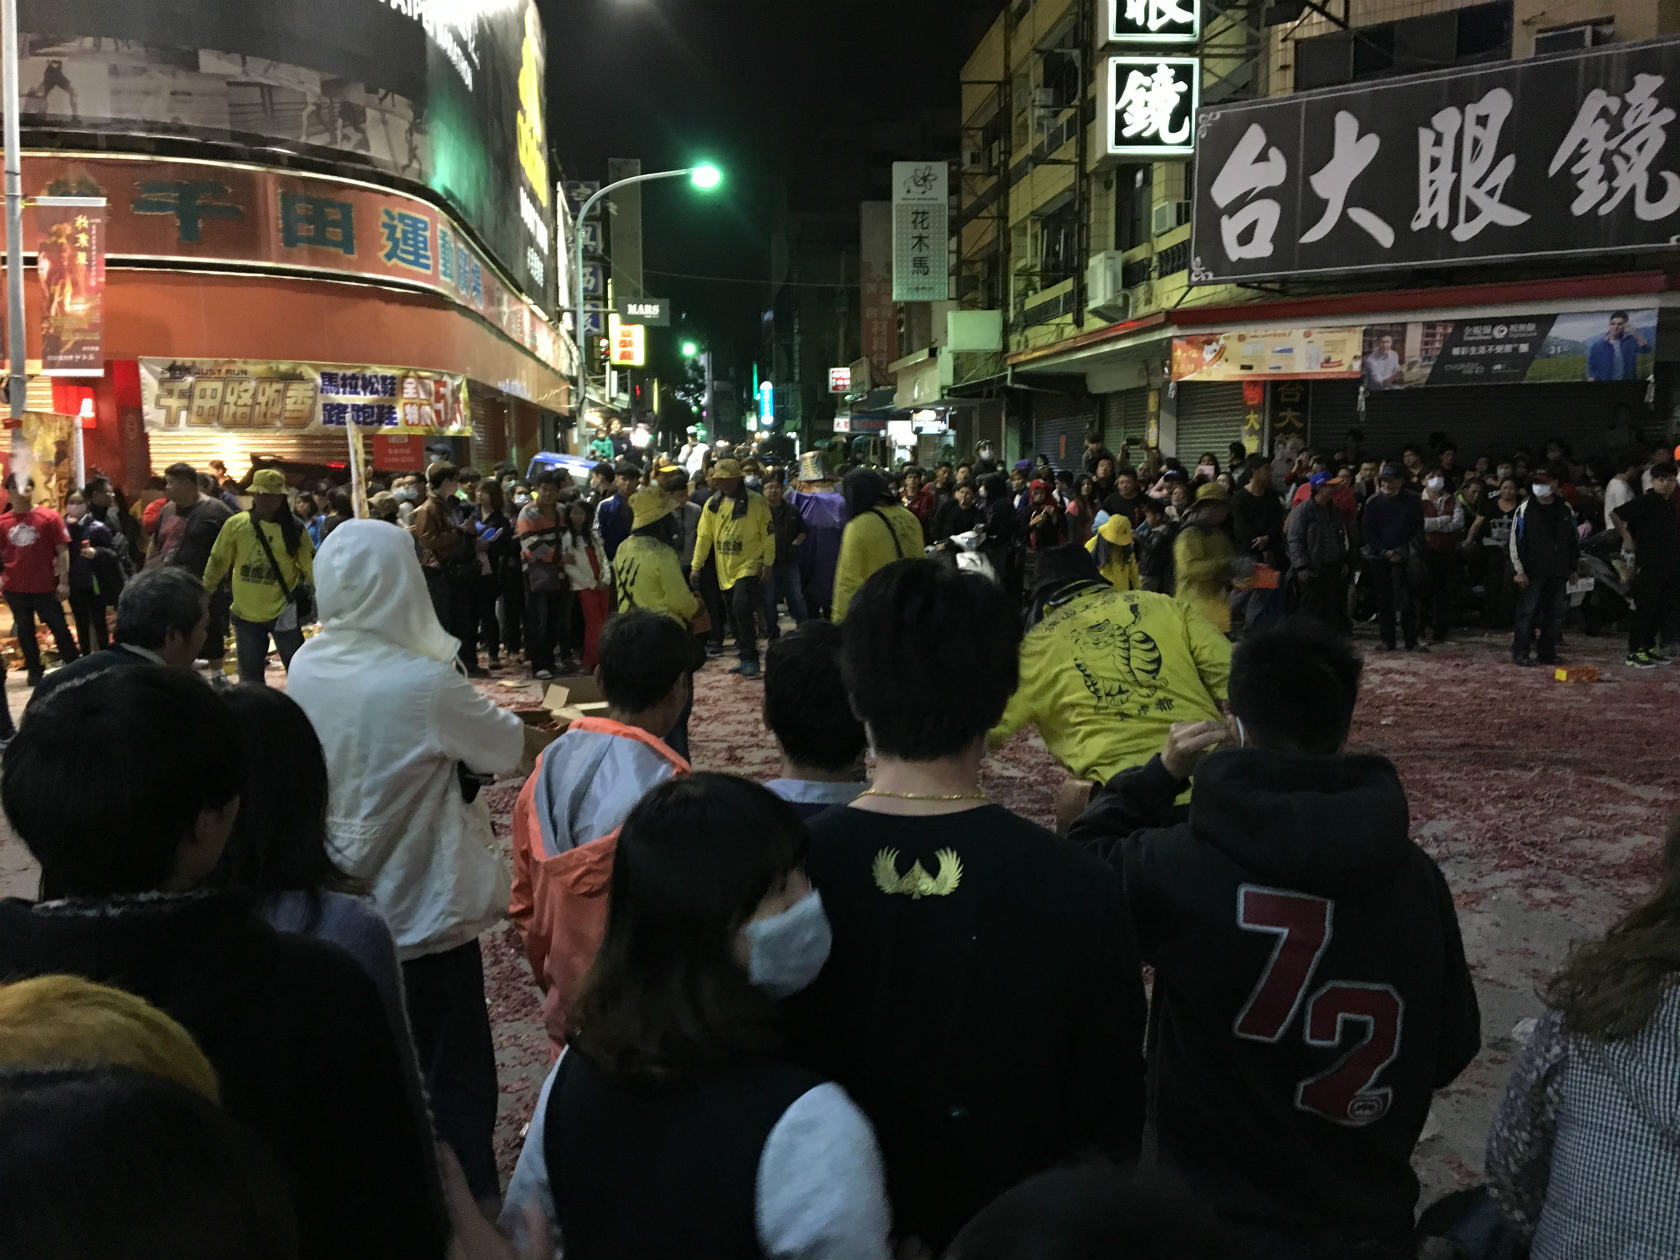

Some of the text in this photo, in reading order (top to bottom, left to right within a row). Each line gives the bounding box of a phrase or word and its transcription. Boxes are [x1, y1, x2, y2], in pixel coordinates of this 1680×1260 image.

[1210, 72, 1680, 262] 台大眼鏡
[911, 209, 930, 276] 花木馬
[627, 303, 660, 315] MARS
[225, 368, 248, 376] RUN
[319, 371, 397, 397] 馬拉松鞋
[155, 376, 318, 428] 千田路跑季
[321, 402, 399, 426] 路跑鞋
[1234, 883, 1404, 1126] 72
